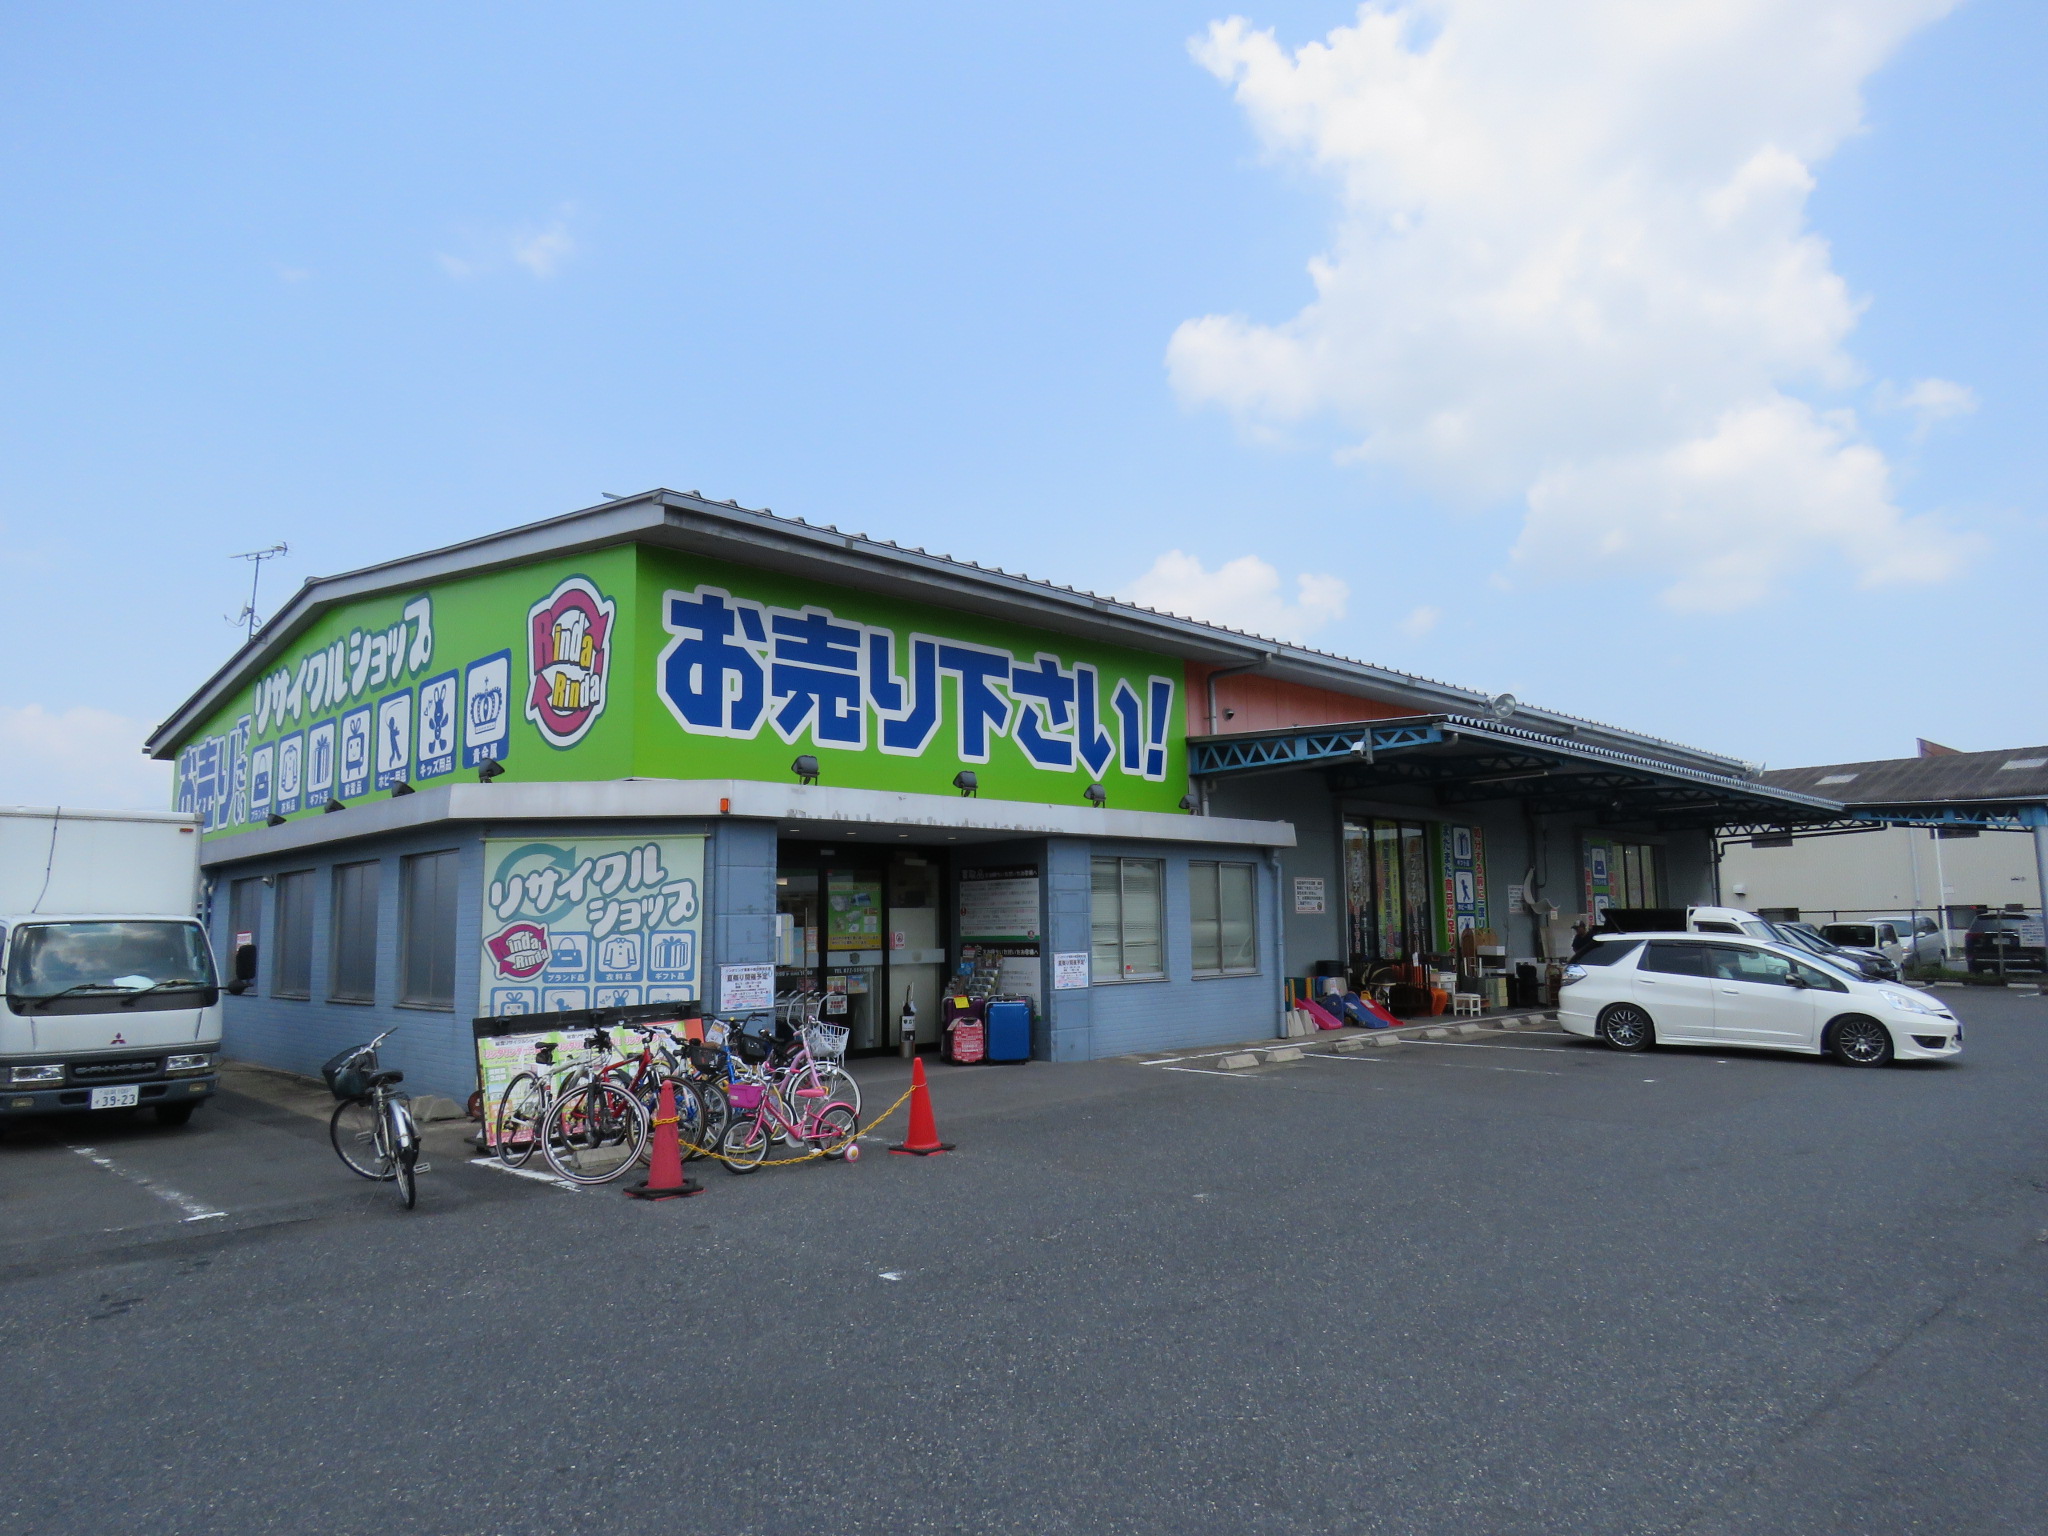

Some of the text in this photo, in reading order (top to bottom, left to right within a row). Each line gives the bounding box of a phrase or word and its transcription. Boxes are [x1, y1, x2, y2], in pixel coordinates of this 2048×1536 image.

[532, 609, 594, 676] Rinda
[254, 595, 433, 735] リサイクルショップ
[551, 671, 600, 711] Rinda
[472, 742, 498, 764] 貴金属
[420, 755, 453, 778] キッズ用品
[344, 780, 363, 797] 家電品
[378, 768, 407, 789] ホビー用品
[281, 799, 296, 814] 衣料品
[310, 790, 329, 806] ギフト品
[251, 806, 270, 821] ブランド品
[490, 845, 667, 921] リサイクル
[587, 878, 697, 941] ショップ
[513, 949, 549, 971] Rinda
[547, 973, 585, 982] ブランド品
[605, 972, 633, 981] 衣料品
[654, 972, 685, 981] ギフト品
[102, 1094, 136, 1107] 39-23
